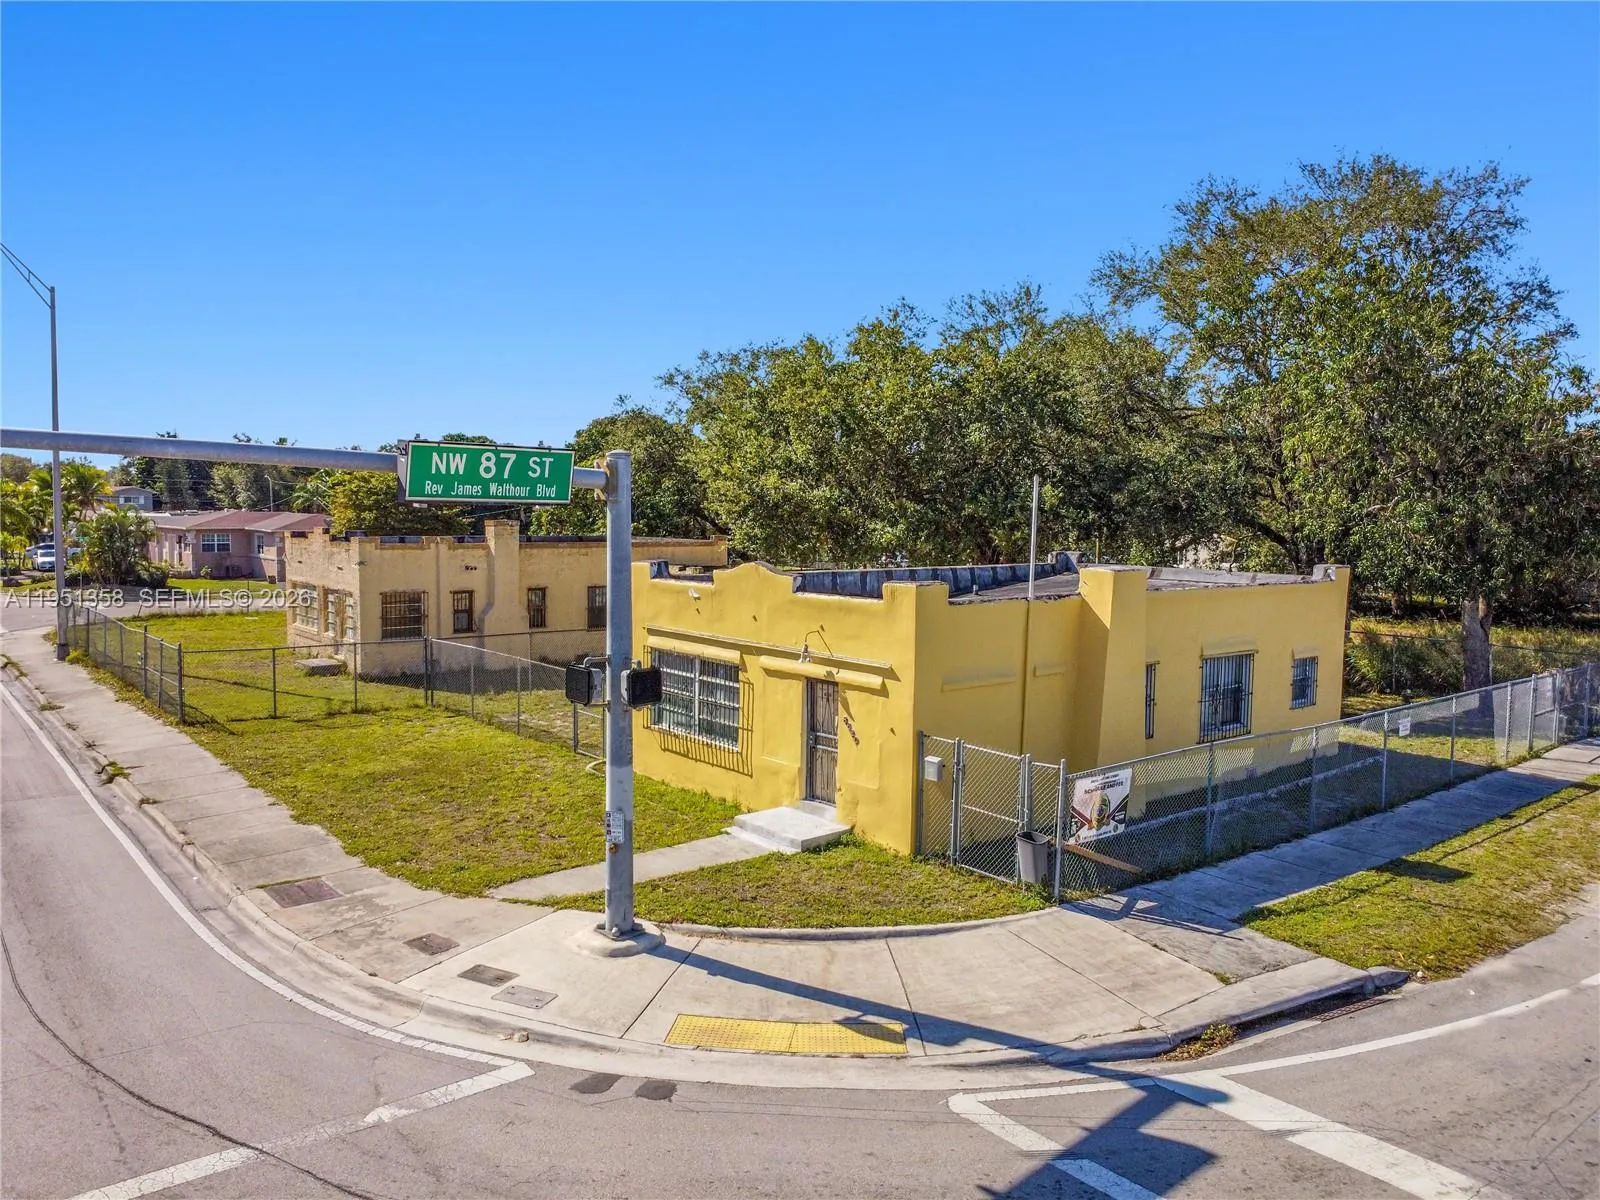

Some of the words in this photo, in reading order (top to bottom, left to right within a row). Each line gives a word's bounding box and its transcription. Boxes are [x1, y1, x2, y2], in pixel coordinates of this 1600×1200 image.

[431, 452, 467, 475] NW
[479, 451, 517, 479] 87
[527, 456, 554, 478] ST
[425, 480, 443, 495] Rev
[450, 481, 482, 496] James
[489, 482, 530, 497] Walthour
[536, 483, 556, 497] Blvd
